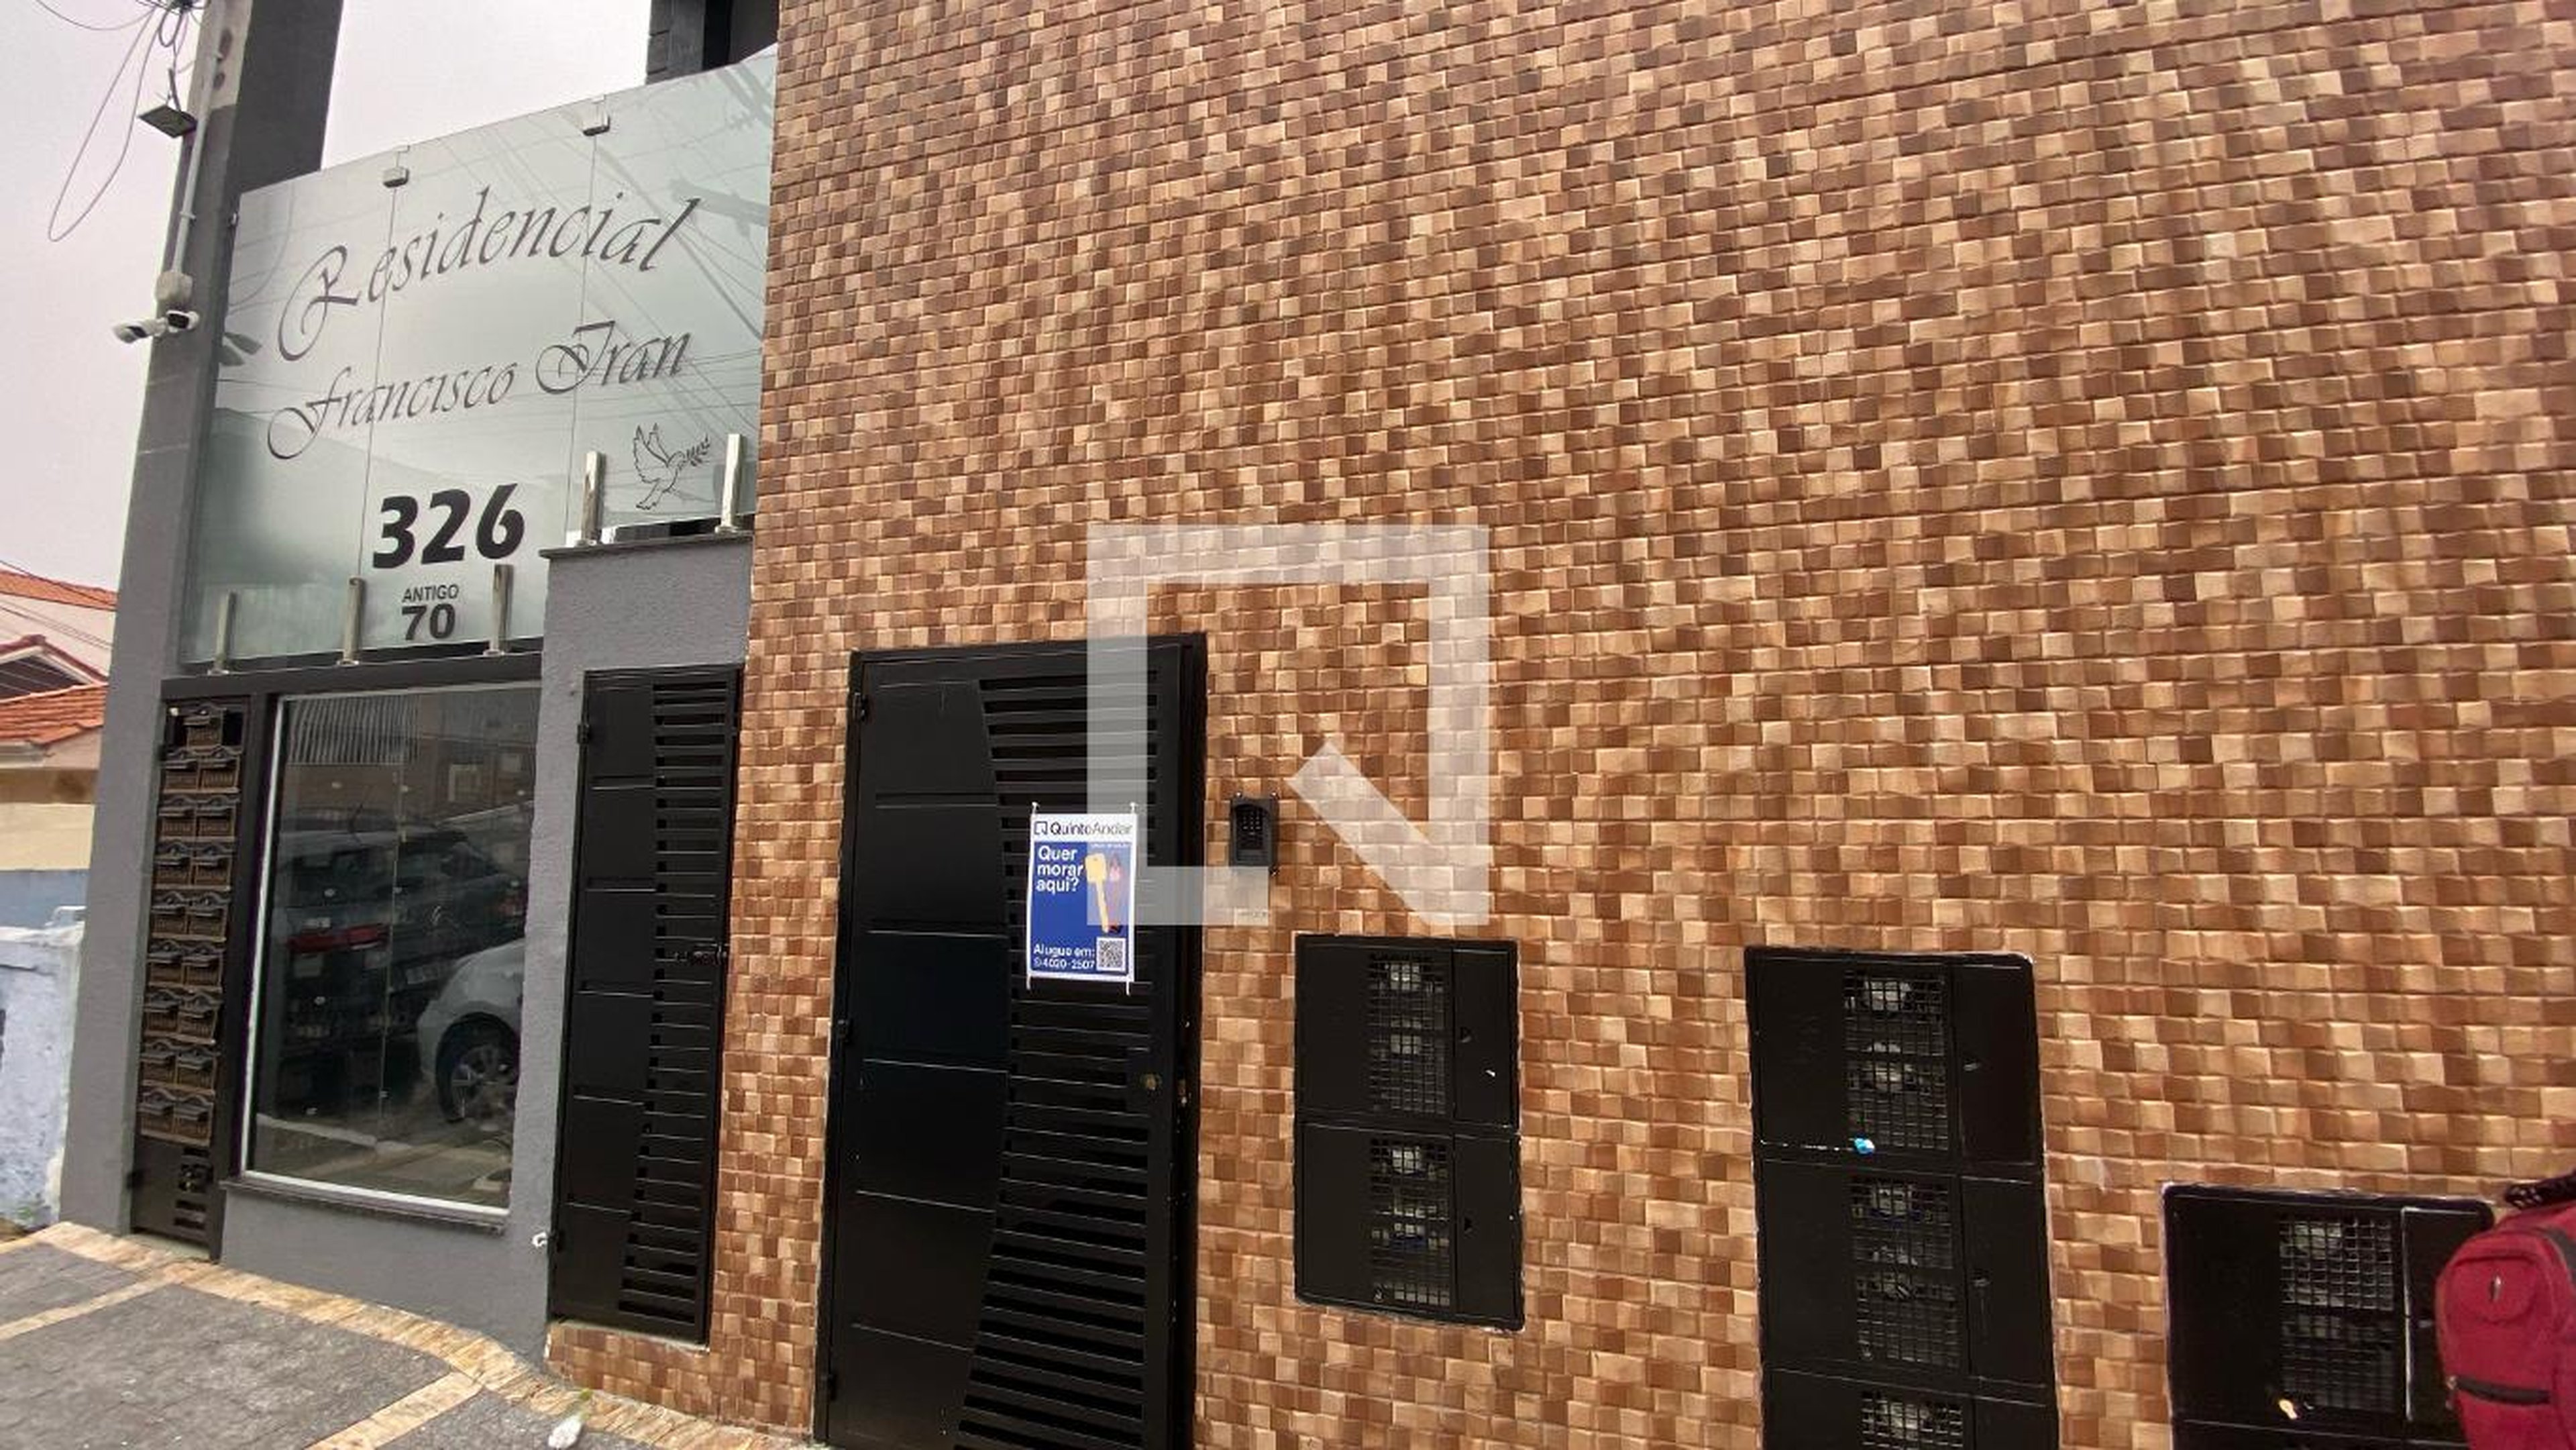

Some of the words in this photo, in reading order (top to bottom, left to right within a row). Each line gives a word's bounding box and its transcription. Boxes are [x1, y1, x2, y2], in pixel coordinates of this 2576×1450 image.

[278, 186, 701, 361] Residencial
[268, 360, 518, 460] Francisco
[536, 320, 692, 395] Iran
[373, 483, 525, 569] 326
[402, 584, 460, 603] ANTIGO
[402, 603, 455, 640] 70
[1050, 821, 1132, 835] QuintoAndar
[1038, 845, 1077, 862] Quer
[1037, 863, 1083, 877] morar
[1036, 876, 1079, 894] aqui?
[1033, 943, 1072, 957] Alugue
[1073, 948, 1095, 957] em:
